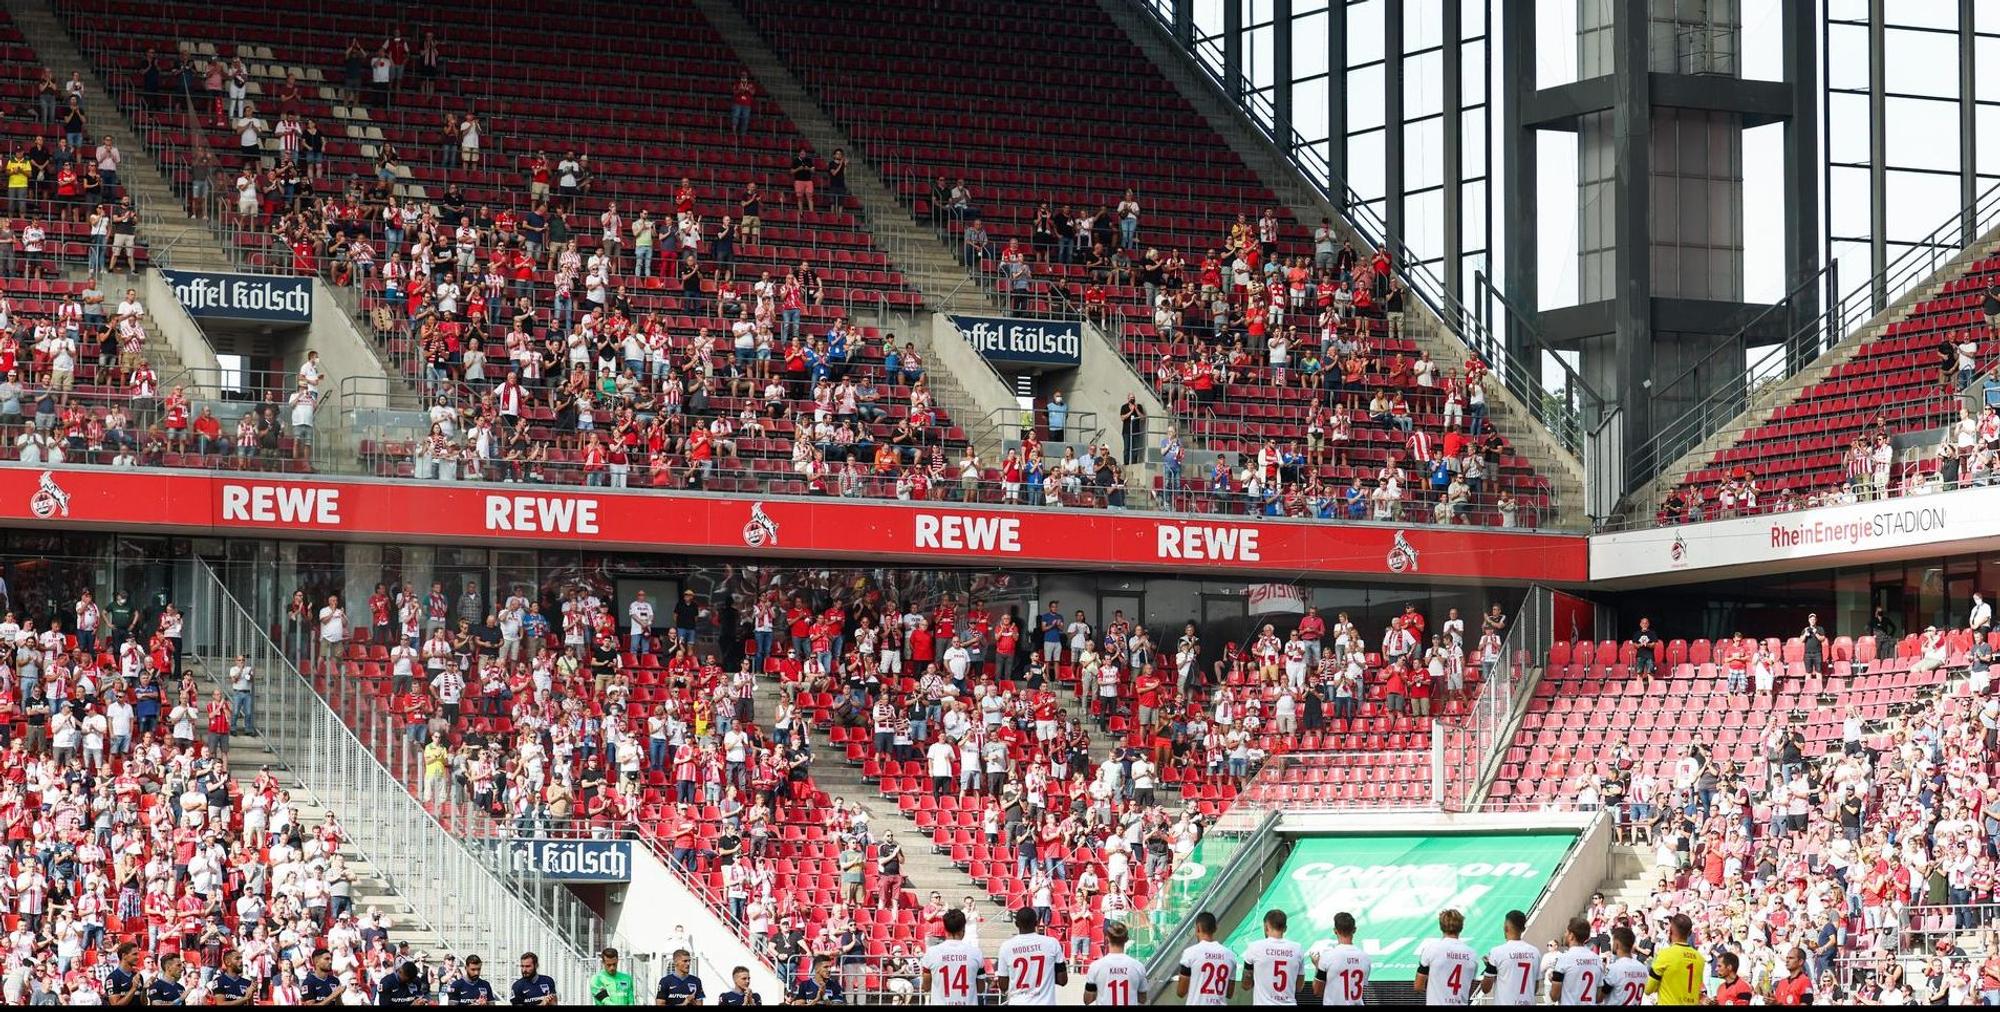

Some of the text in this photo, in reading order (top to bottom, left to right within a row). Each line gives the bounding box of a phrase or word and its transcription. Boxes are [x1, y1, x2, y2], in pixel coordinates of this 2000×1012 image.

[166, 277, 310, 316] affel Kölsch
[1010, 325, 1079, 359] Kölsch
[223, 485, 340, 524] REWE
[485, 495, 599, 534] REWE
[915, 514, 1021, 552] REWE
[1157, 525, 1260, 562] REWE
[542, 842, 627, 879] Kölsch
[941, 954, 968, 962] HECTOR
[1012, 944, 1042, 954] MODESTE
[1265, 948, 1293, 958] CZICHOS
[939, 964, 969, 998] 14
[1013, 955, 1045, 990] 27
[1109, 967, 1128, 975] KAINZ
[1200, 961, 1229, 995] 28
[1273, 960, 1288, 992] 5
[1340, 968, 1364, 1001] 13
[1447, 963, 1462, 995] 4
[1517, 962, 1531, 995] 7
[1580, 970, 1594, 1002] 2
[1686, 962, 1694, 993] 1
[1108, 979, 1129, 1006] 11
[1623, 981, 1645, 1005] 29
